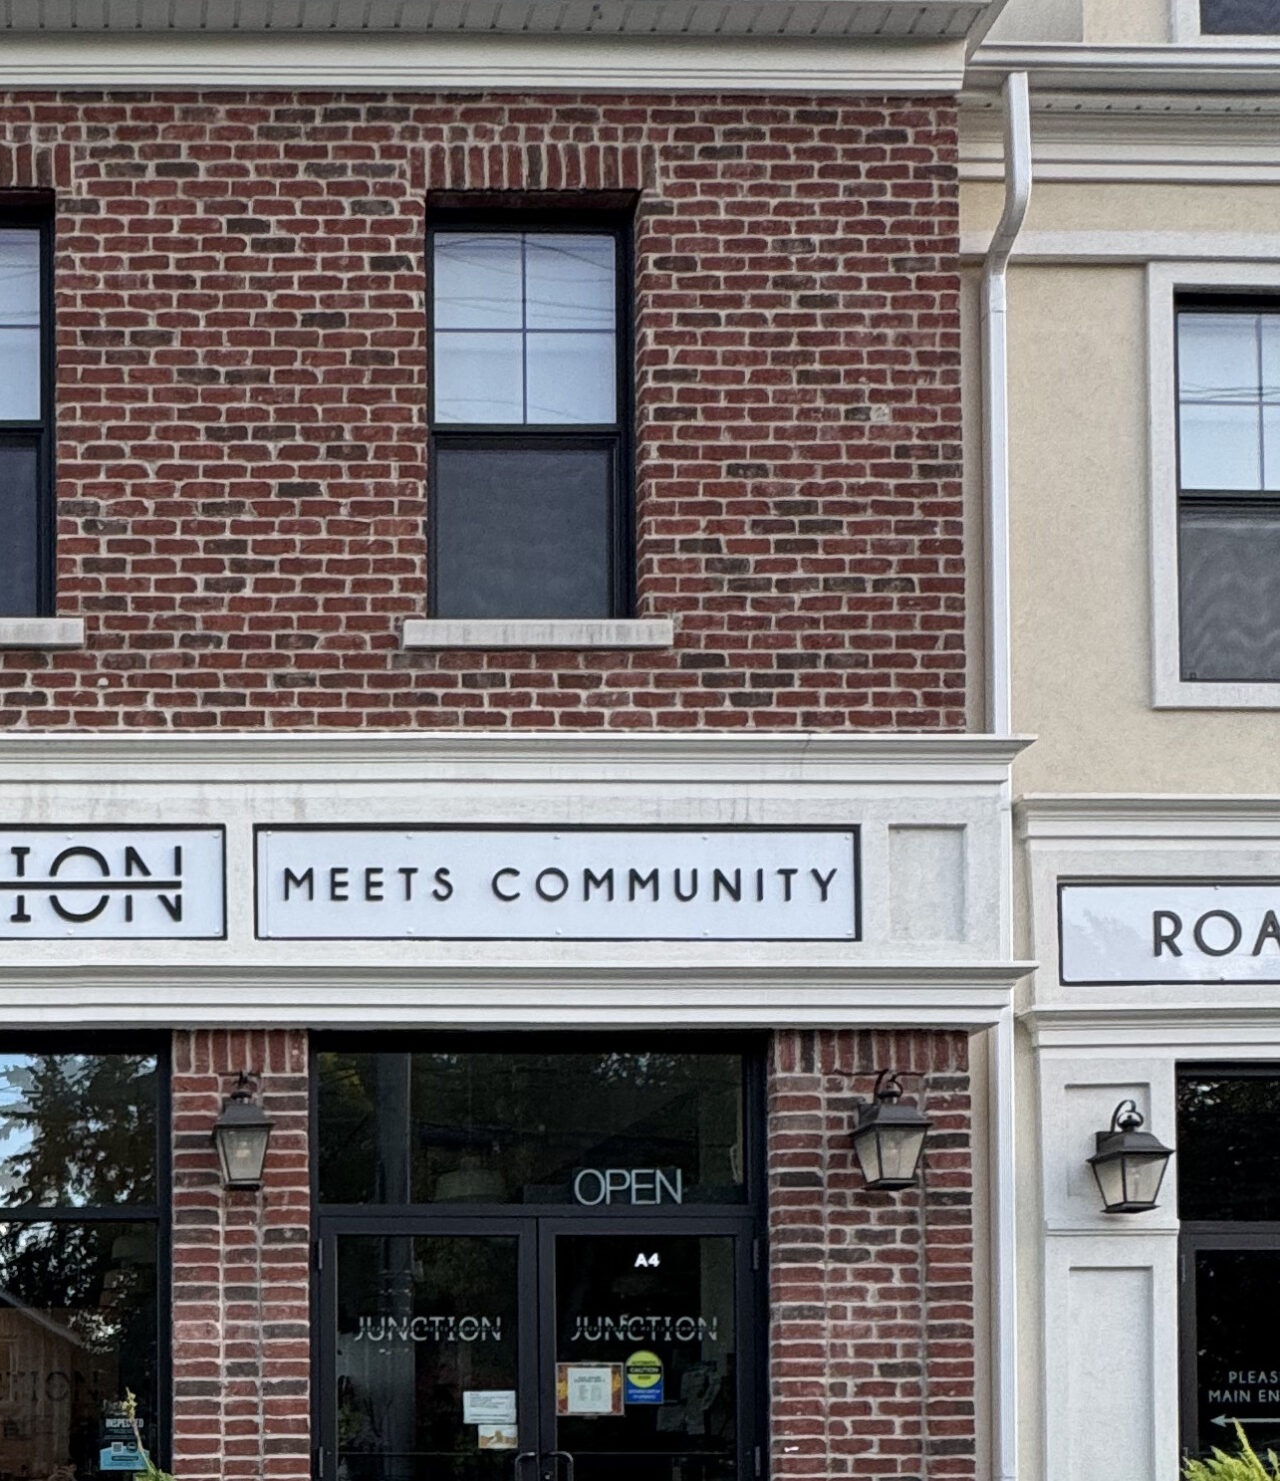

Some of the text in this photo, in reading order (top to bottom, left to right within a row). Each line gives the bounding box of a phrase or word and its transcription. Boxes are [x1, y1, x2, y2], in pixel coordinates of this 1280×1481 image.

[283, 867, 838, 903] MEETS COMMUNITY
[574, 1168, 682, 1206] OPEN
[634, 1252, 660, 1268] A4
[354, 1315, 502, 1342] JUNCTION
[571, 1315, 718, 1342] JUNCTION
[1208, 1389, 1251, 1403] MAIN
